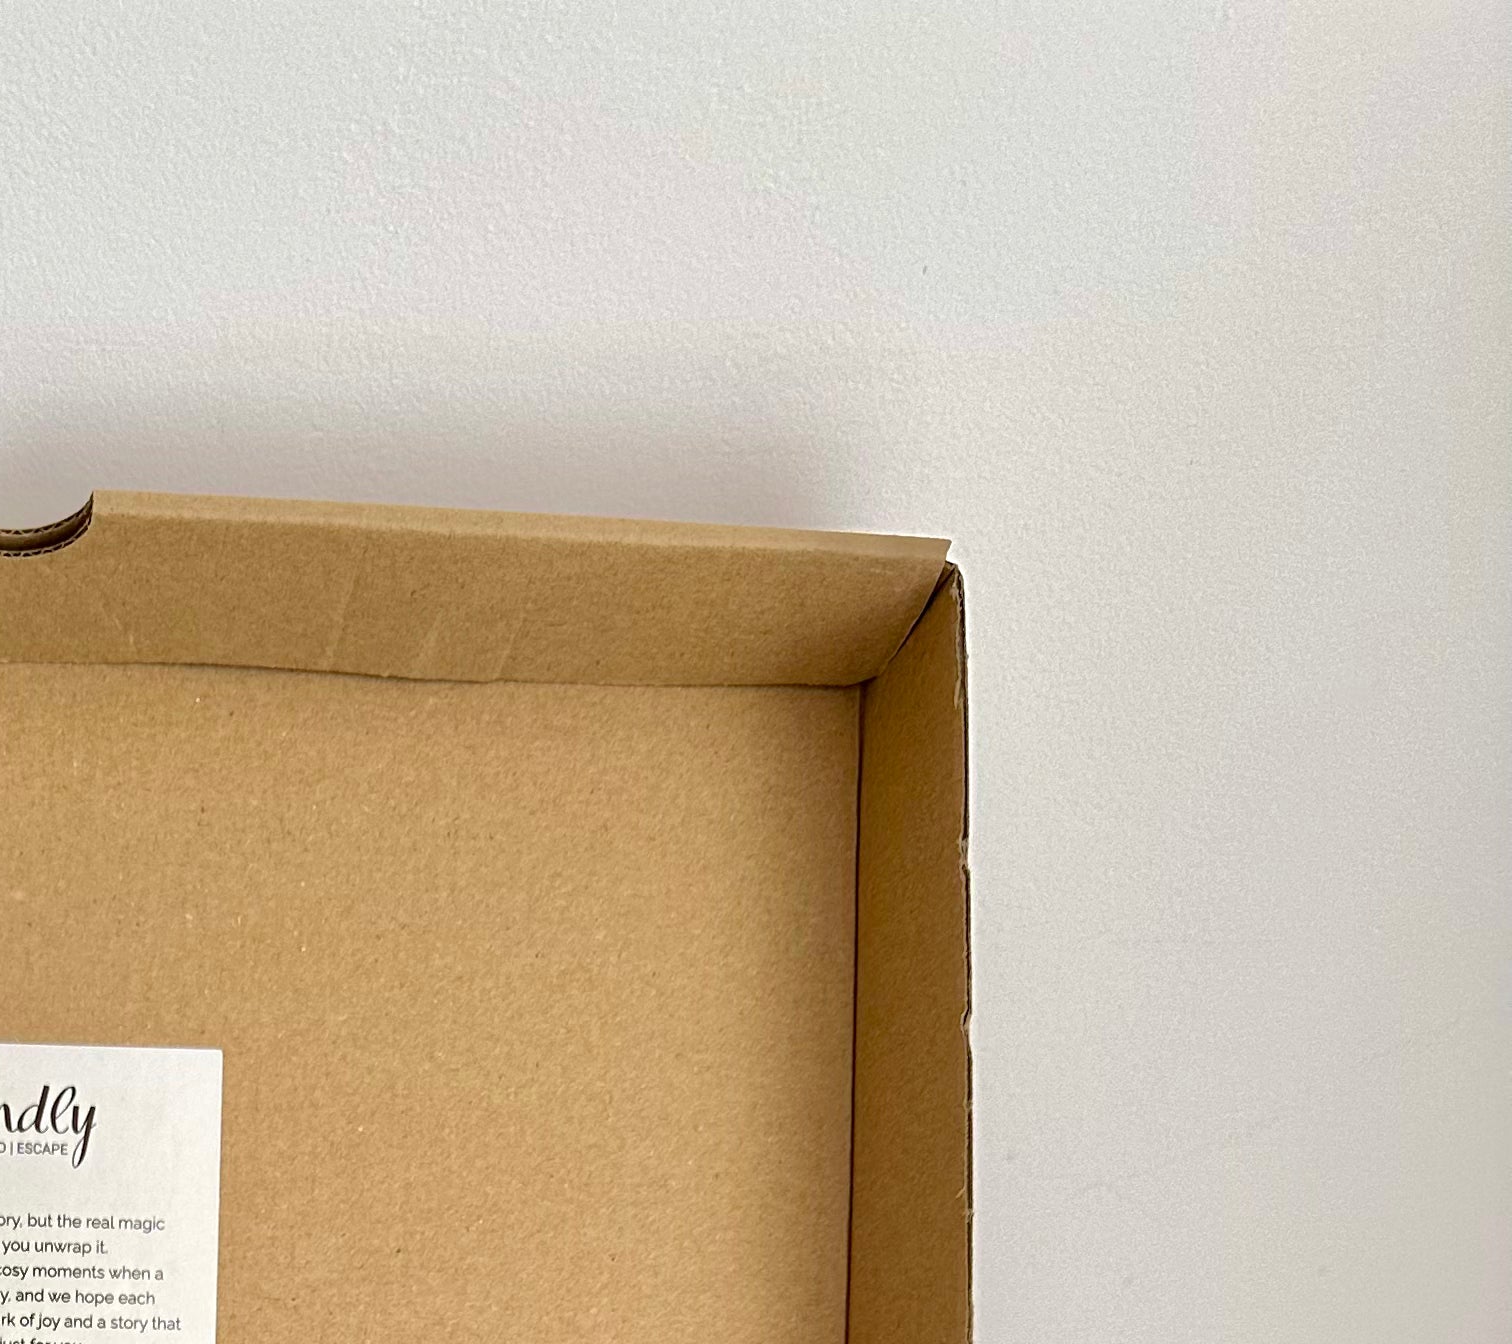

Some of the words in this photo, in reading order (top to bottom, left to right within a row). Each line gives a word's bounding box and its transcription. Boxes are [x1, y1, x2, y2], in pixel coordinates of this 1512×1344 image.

[17, 1141, 69, 1156] ESCAPE
[27, 1212, 54, 1228] but
[56, 1213, 83, 1229] the
[85, 1214, 116, 1231] real
[118, 1214, 166, 1234] magic
[1, 1239, 31, 1257] you
[34, 1241, 93, 1259] unwrap
[32, 1264, 106, 1281] moments
[108, 1265, 151, 1281] when
[154, 1269, 164, 1282] a
[15, 1287, 45, 1304] and
[47, 1291, 72, 1305] we
[74, 1289, 115, 1308] hope
[117, 1289, 156, 1306] each
[19, 1312, 36, 1328] of
[35, 1313, 61, 1332] joy
[63, 1313, 94, 1330] and
[96, 1317, 107, 1330] a
[109, 1315, 149, 1334] story
[151, 1315, 182, 1332] that
